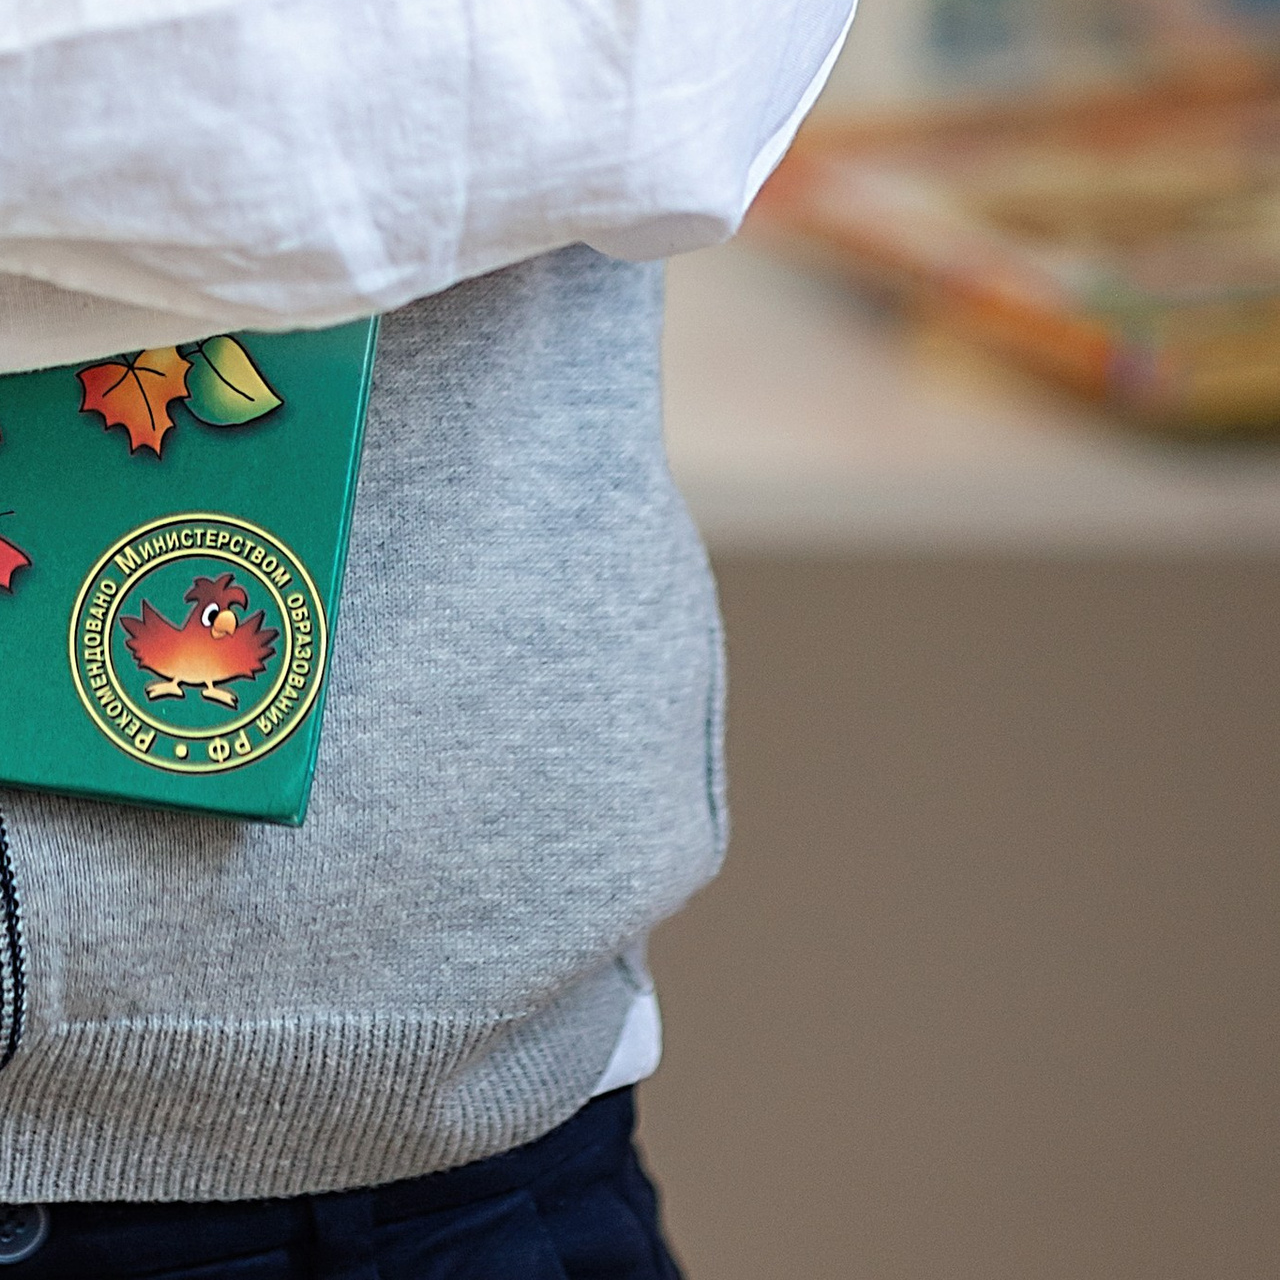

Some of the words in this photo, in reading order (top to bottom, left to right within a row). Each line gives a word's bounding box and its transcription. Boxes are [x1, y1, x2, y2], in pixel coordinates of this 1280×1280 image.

[114, 528, 292, 589] МИНИСТЕРСТВОМ
[83, 578, 157, 753] РЕКОМЕНДОВАНО
[256, 592, 313, 737] ОБРАЗОВАНИЯ
[208, 730, 252, 764] РФ
